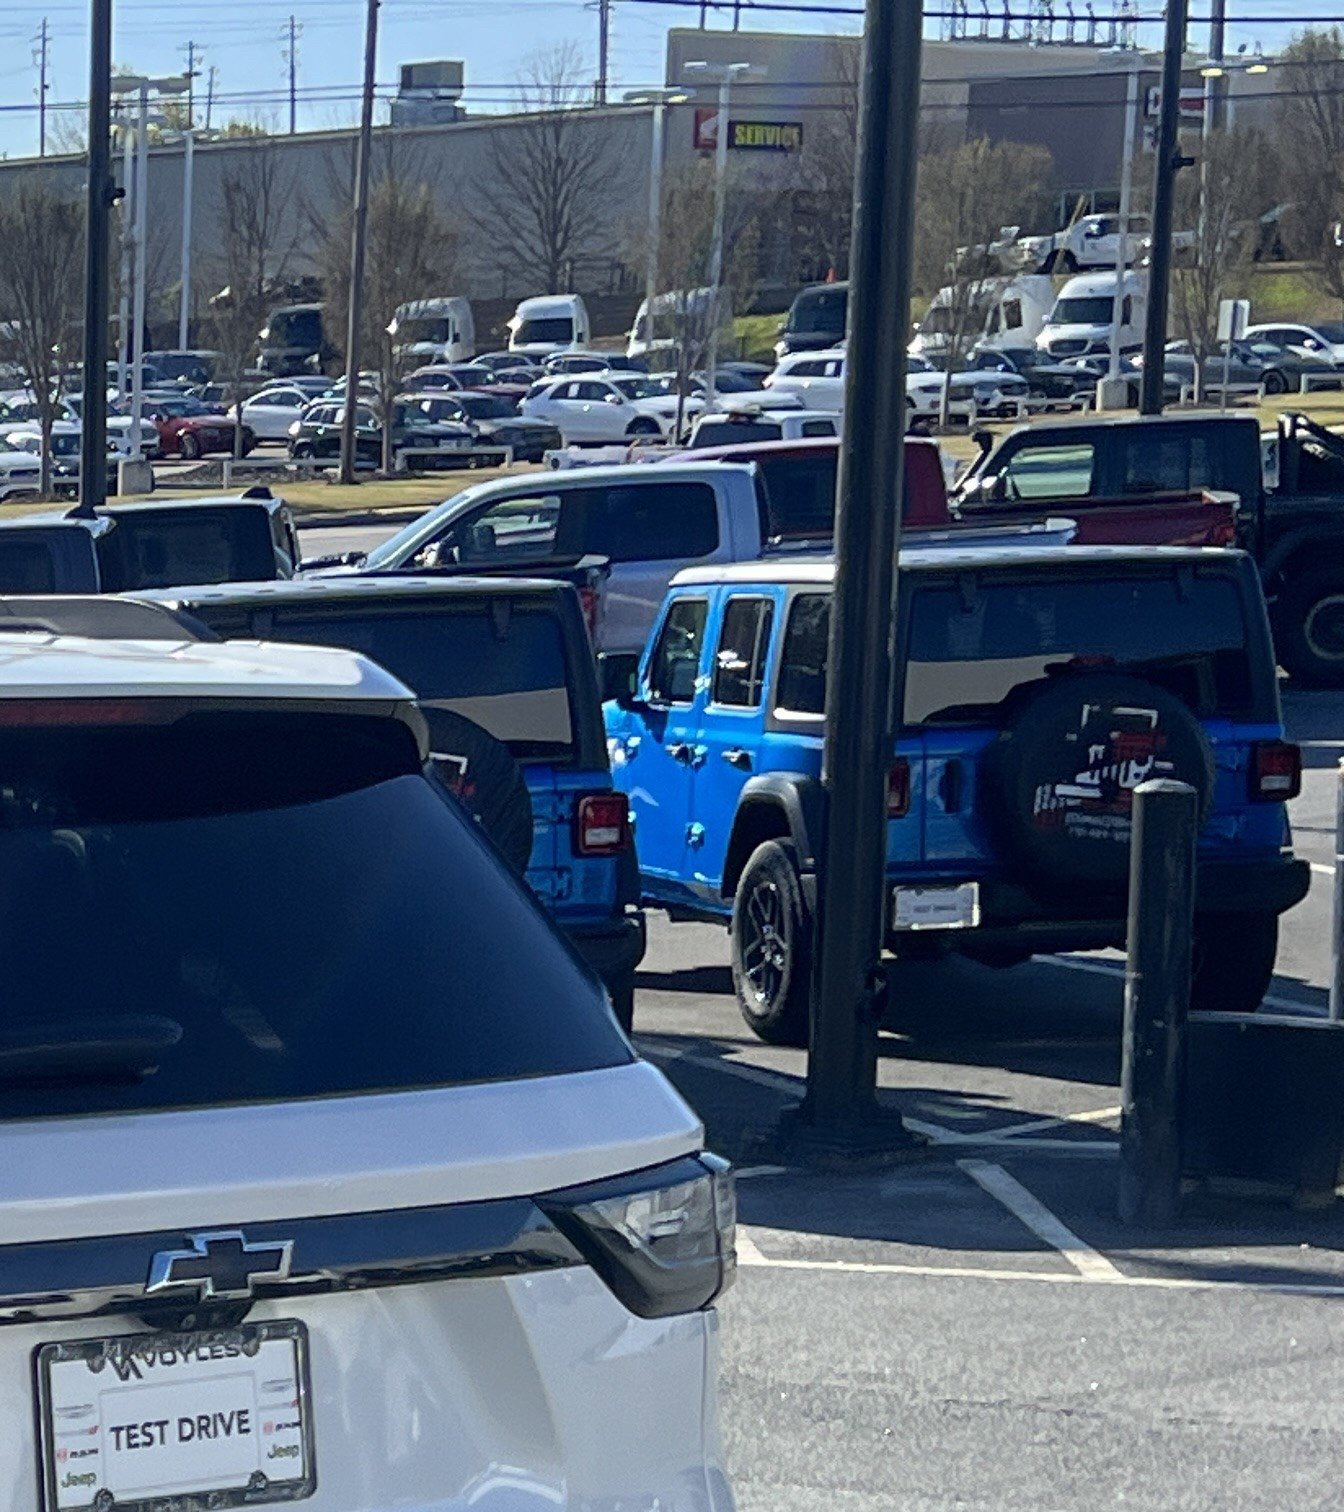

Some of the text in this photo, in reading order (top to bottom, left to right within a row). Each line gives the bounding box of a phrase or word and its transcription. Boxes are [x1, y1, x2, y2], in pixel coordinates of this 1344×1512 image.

[110, 1408, 251, 1451] TEST DRIVE
[61, 1471, 97, 1488] Jeep
